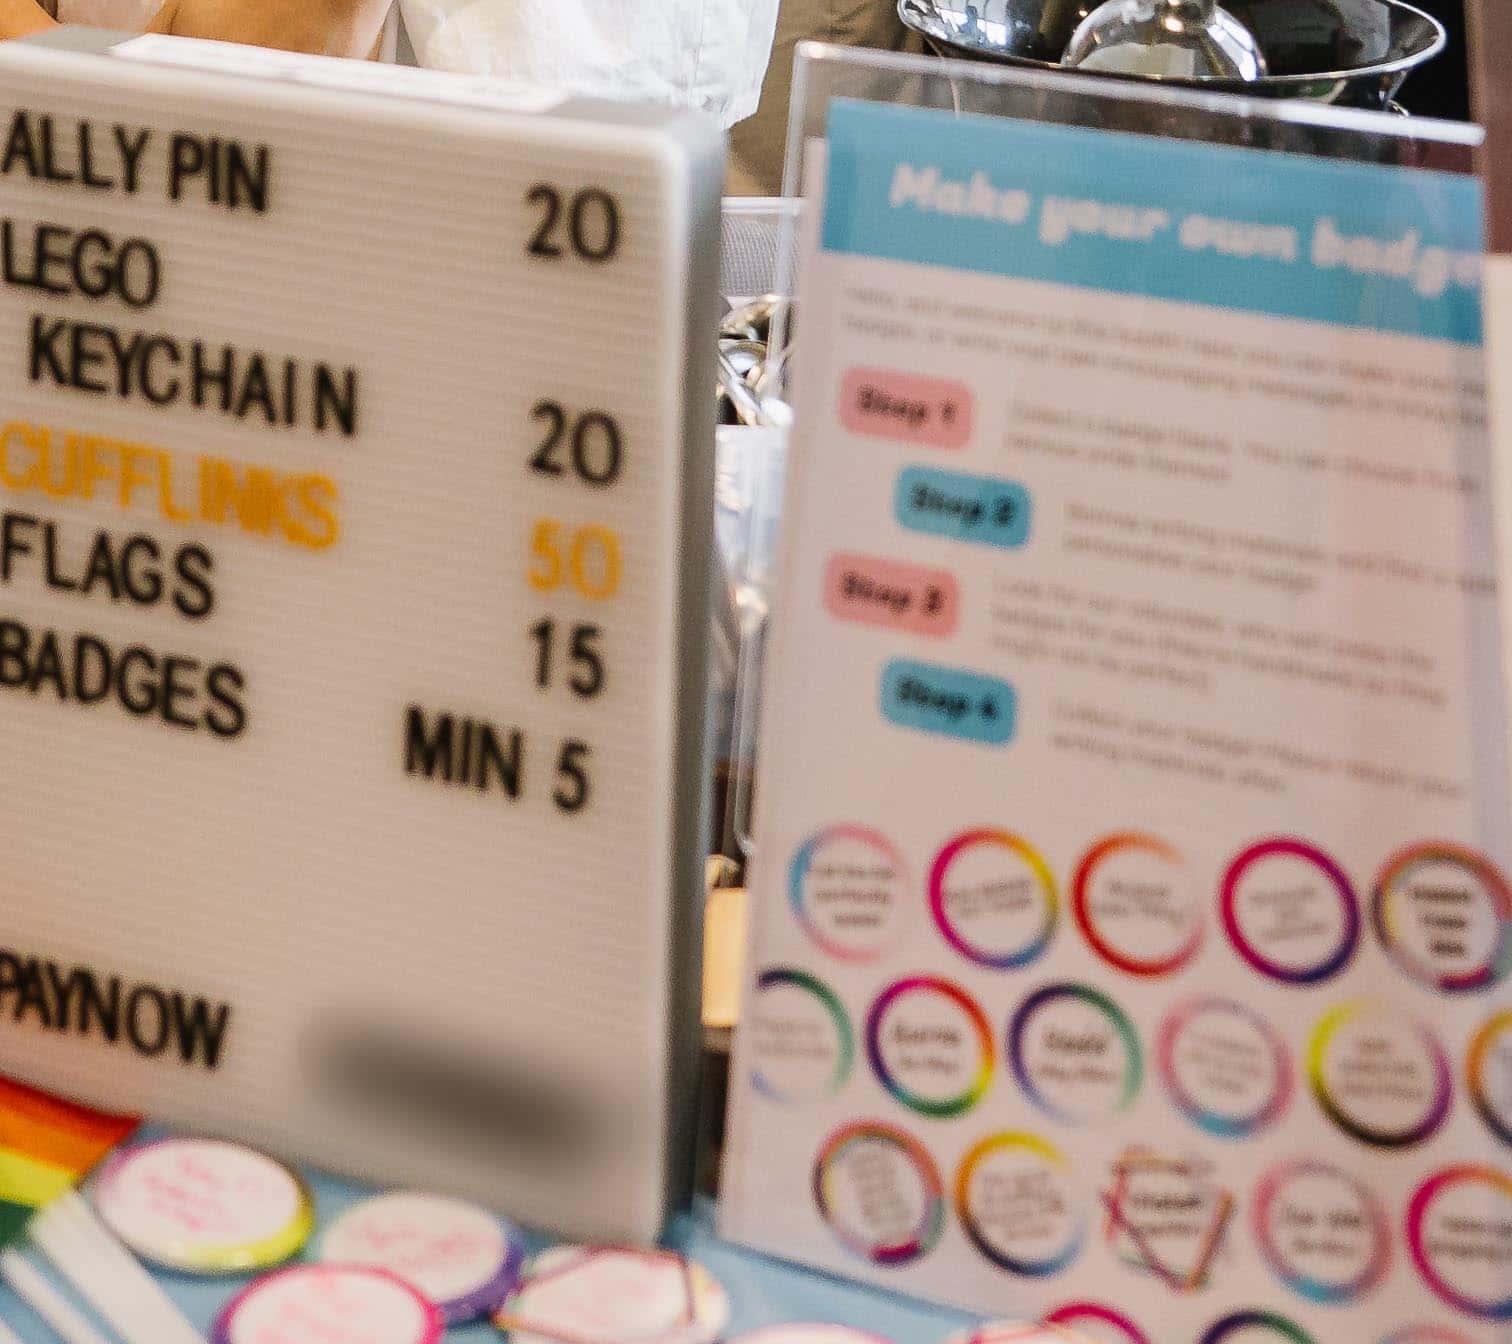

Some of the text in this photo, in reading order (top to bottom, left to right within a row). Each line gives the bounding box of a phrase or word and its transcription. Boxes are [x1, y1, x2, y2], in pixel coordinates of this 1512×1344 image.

[164, 129, 270, 216] PIN
[522, 181, 621, 265] 20
[888, 163, 1032, 224] Make
[1039, 192, 1171, 247] your
[1177, 214, 1298, 263] own
[26, 313, 626, 488] KEYCHAIN 20
[526, 519, 624, 602] 50
[526, 616, 607, 697] 15
[402, 705, 524, 801] MIN
[550, 738, 593, 813] 5
